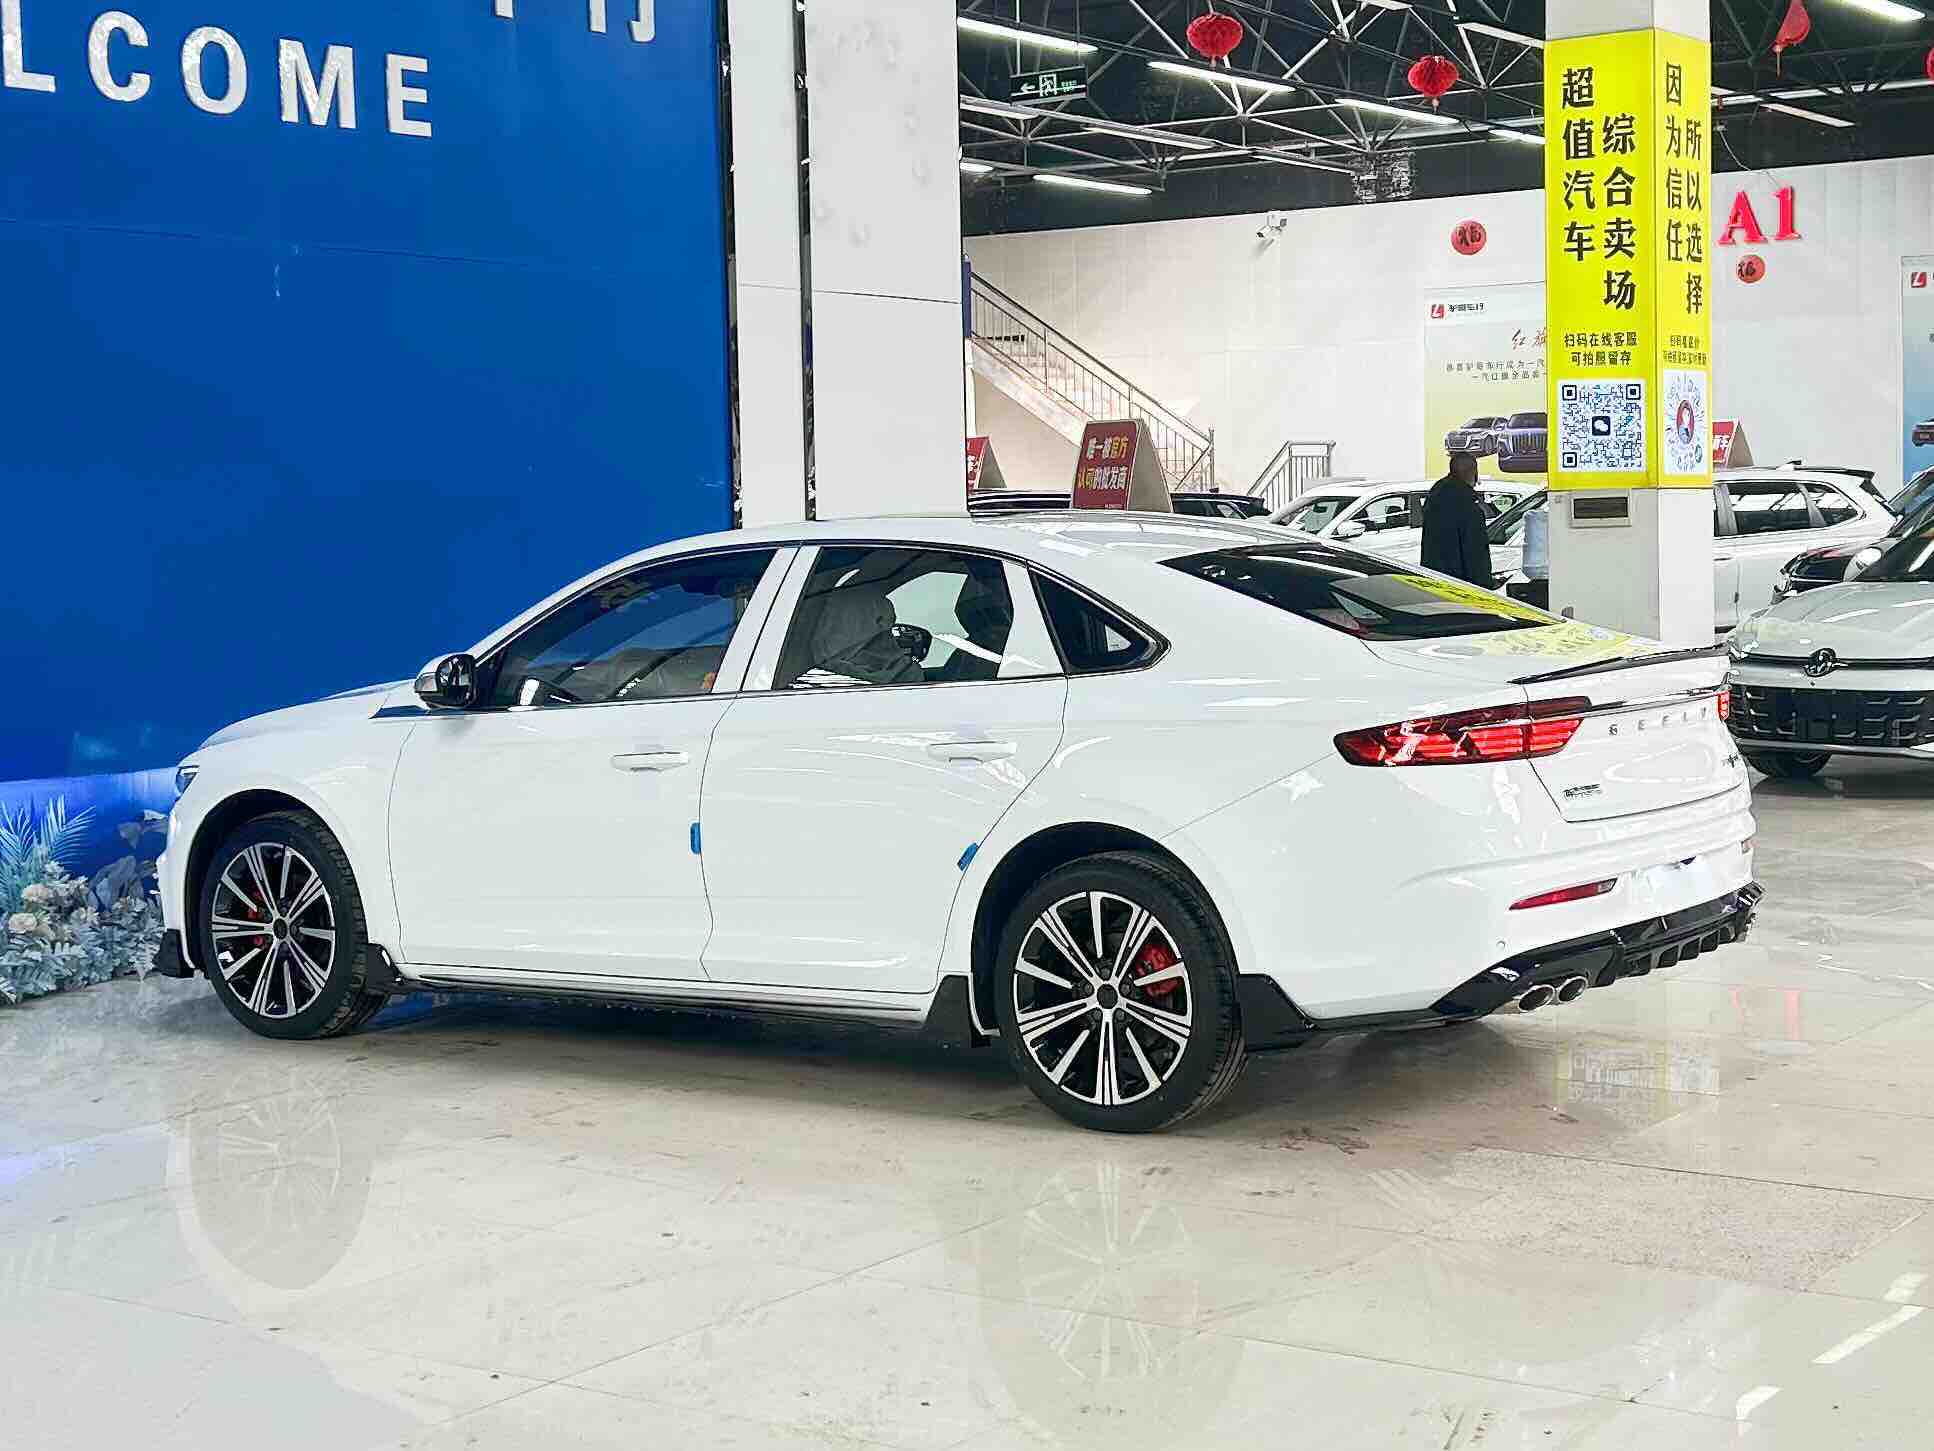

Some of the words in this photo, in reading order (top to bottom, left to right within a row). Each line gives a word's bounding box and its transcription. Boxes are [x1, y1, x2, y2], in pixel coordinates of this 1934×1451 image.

[1562, 66, 1595, 262] 超值汽车
[1602, 112, 1637, 311] 综合卖场
[1666, 61, 1683, 263] 因为信任
[1685, 118, 1703, 315] 所以选择
[1716, 186, 1802, 246] A1
[1564, 331, 1638, 348] 扫码在线客服
[1571, 350, 1632, 367] 可拍照留存
